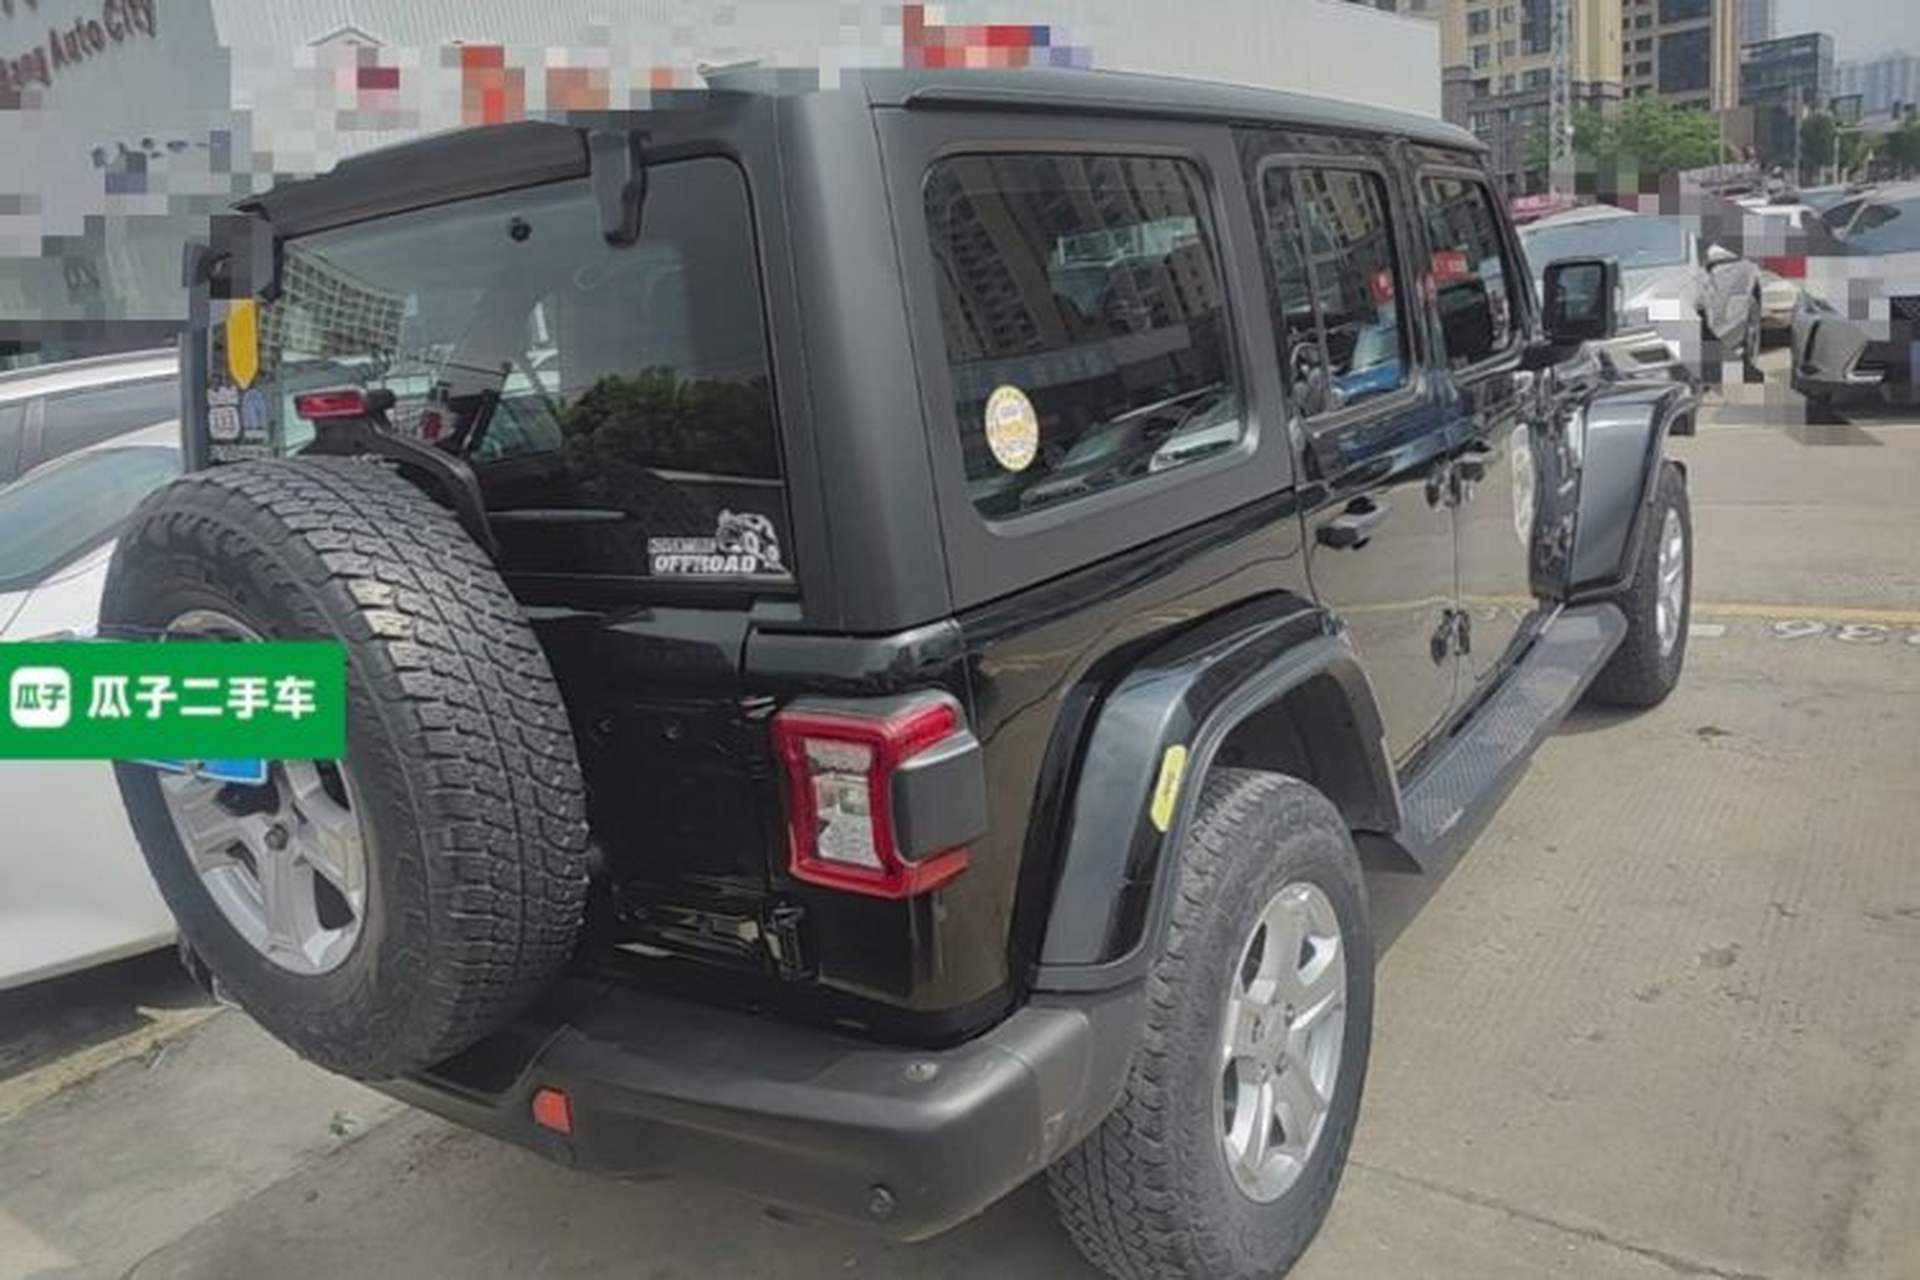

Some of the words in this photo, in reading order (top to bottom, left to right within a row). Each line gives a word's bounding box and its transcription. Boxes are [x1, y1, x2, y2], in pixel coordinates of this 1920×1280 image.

[48, 17, 106, 69] Auto
[103, 0, 157, 42] City
[654, 554, 758, 573] OFFROAD
